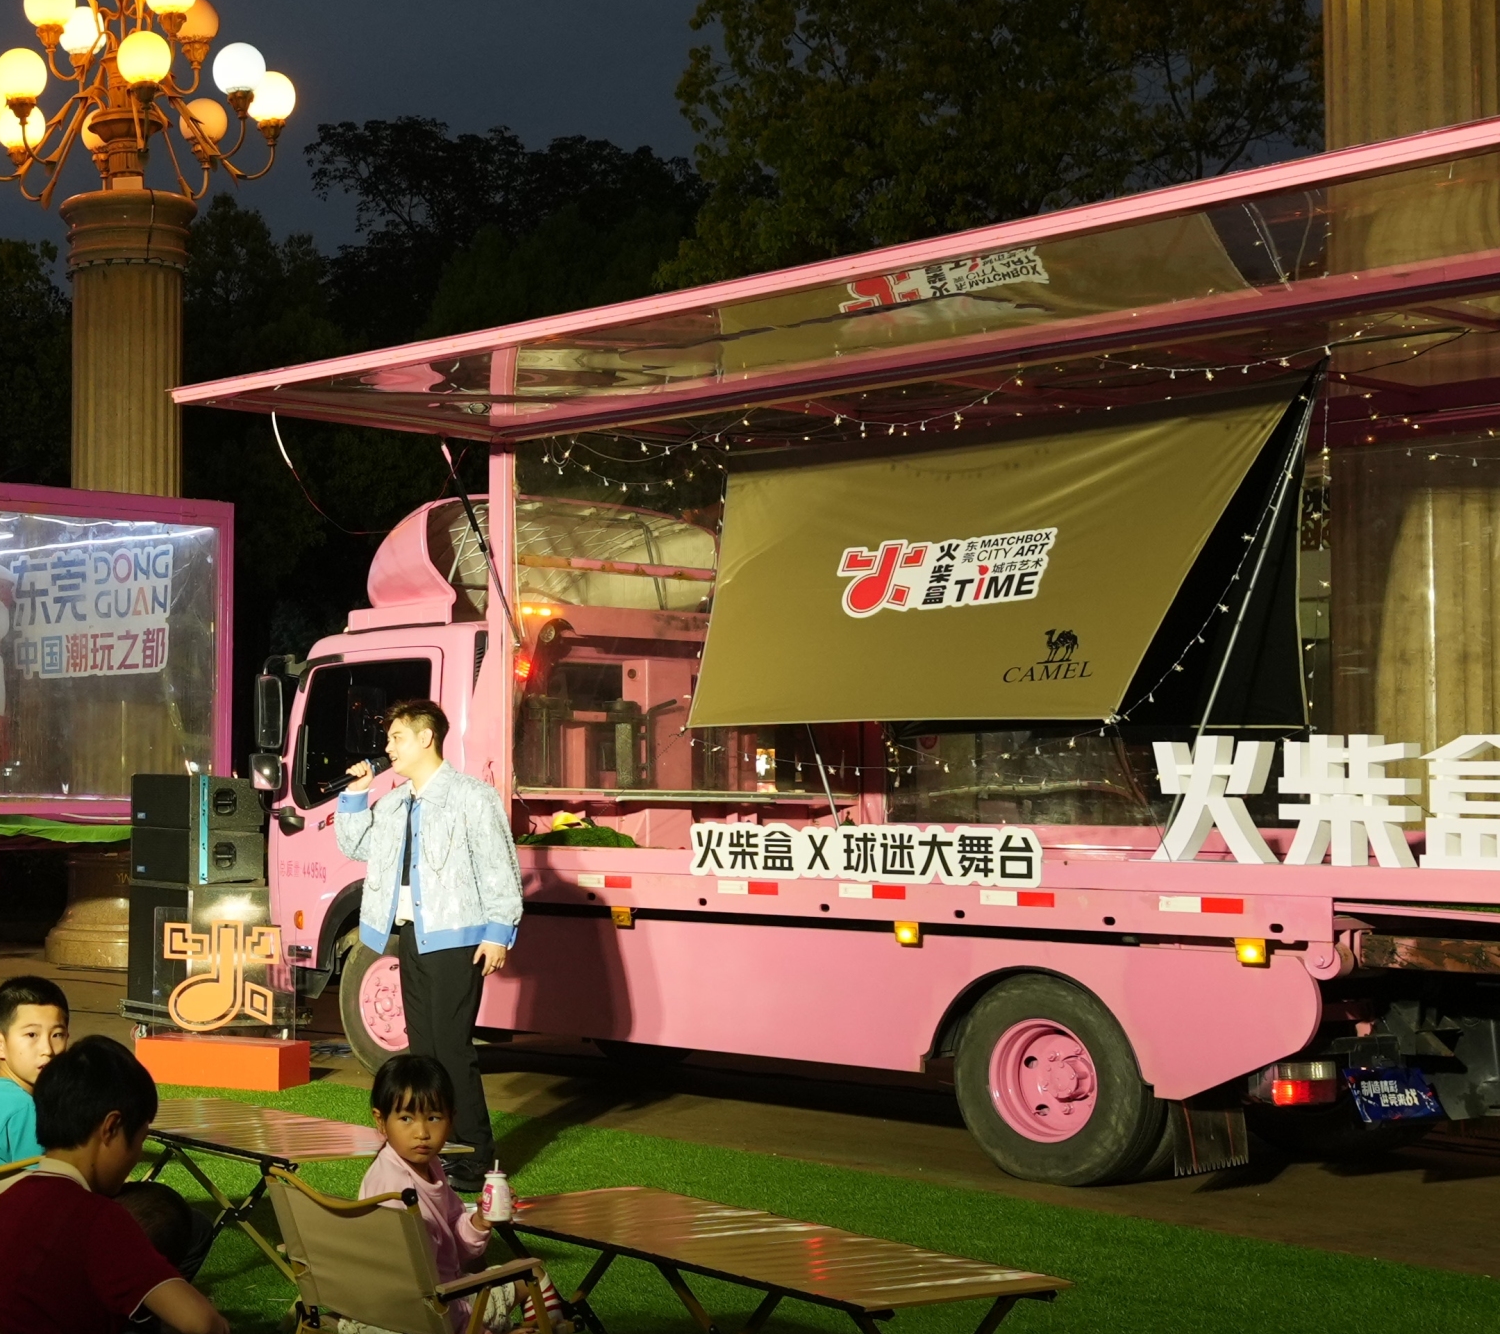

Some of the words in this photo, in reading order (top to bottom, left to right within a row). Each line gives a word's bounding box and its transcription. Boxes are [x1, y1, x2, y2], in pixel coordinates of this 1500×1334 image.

[977, 547, 1011, 562] CITY
[1013, 543, 1049, 558] ART
[979, 531, 1053, 549] MATCHBOX
[94, 549, 170, 585] DONG
[991, 557, 1043, 578] 城市艺术
[12, 555, 87, 627] 东莞
[94, 584, 168, 618] GUAN
[16, 628, 166, 676] 中国潮玩之都
[1002, 660, 1093, 683] CAMEL
[696, 829, 794, 872] 火柴盒
[843, 832, 1034, 880] 球迷大舞台
